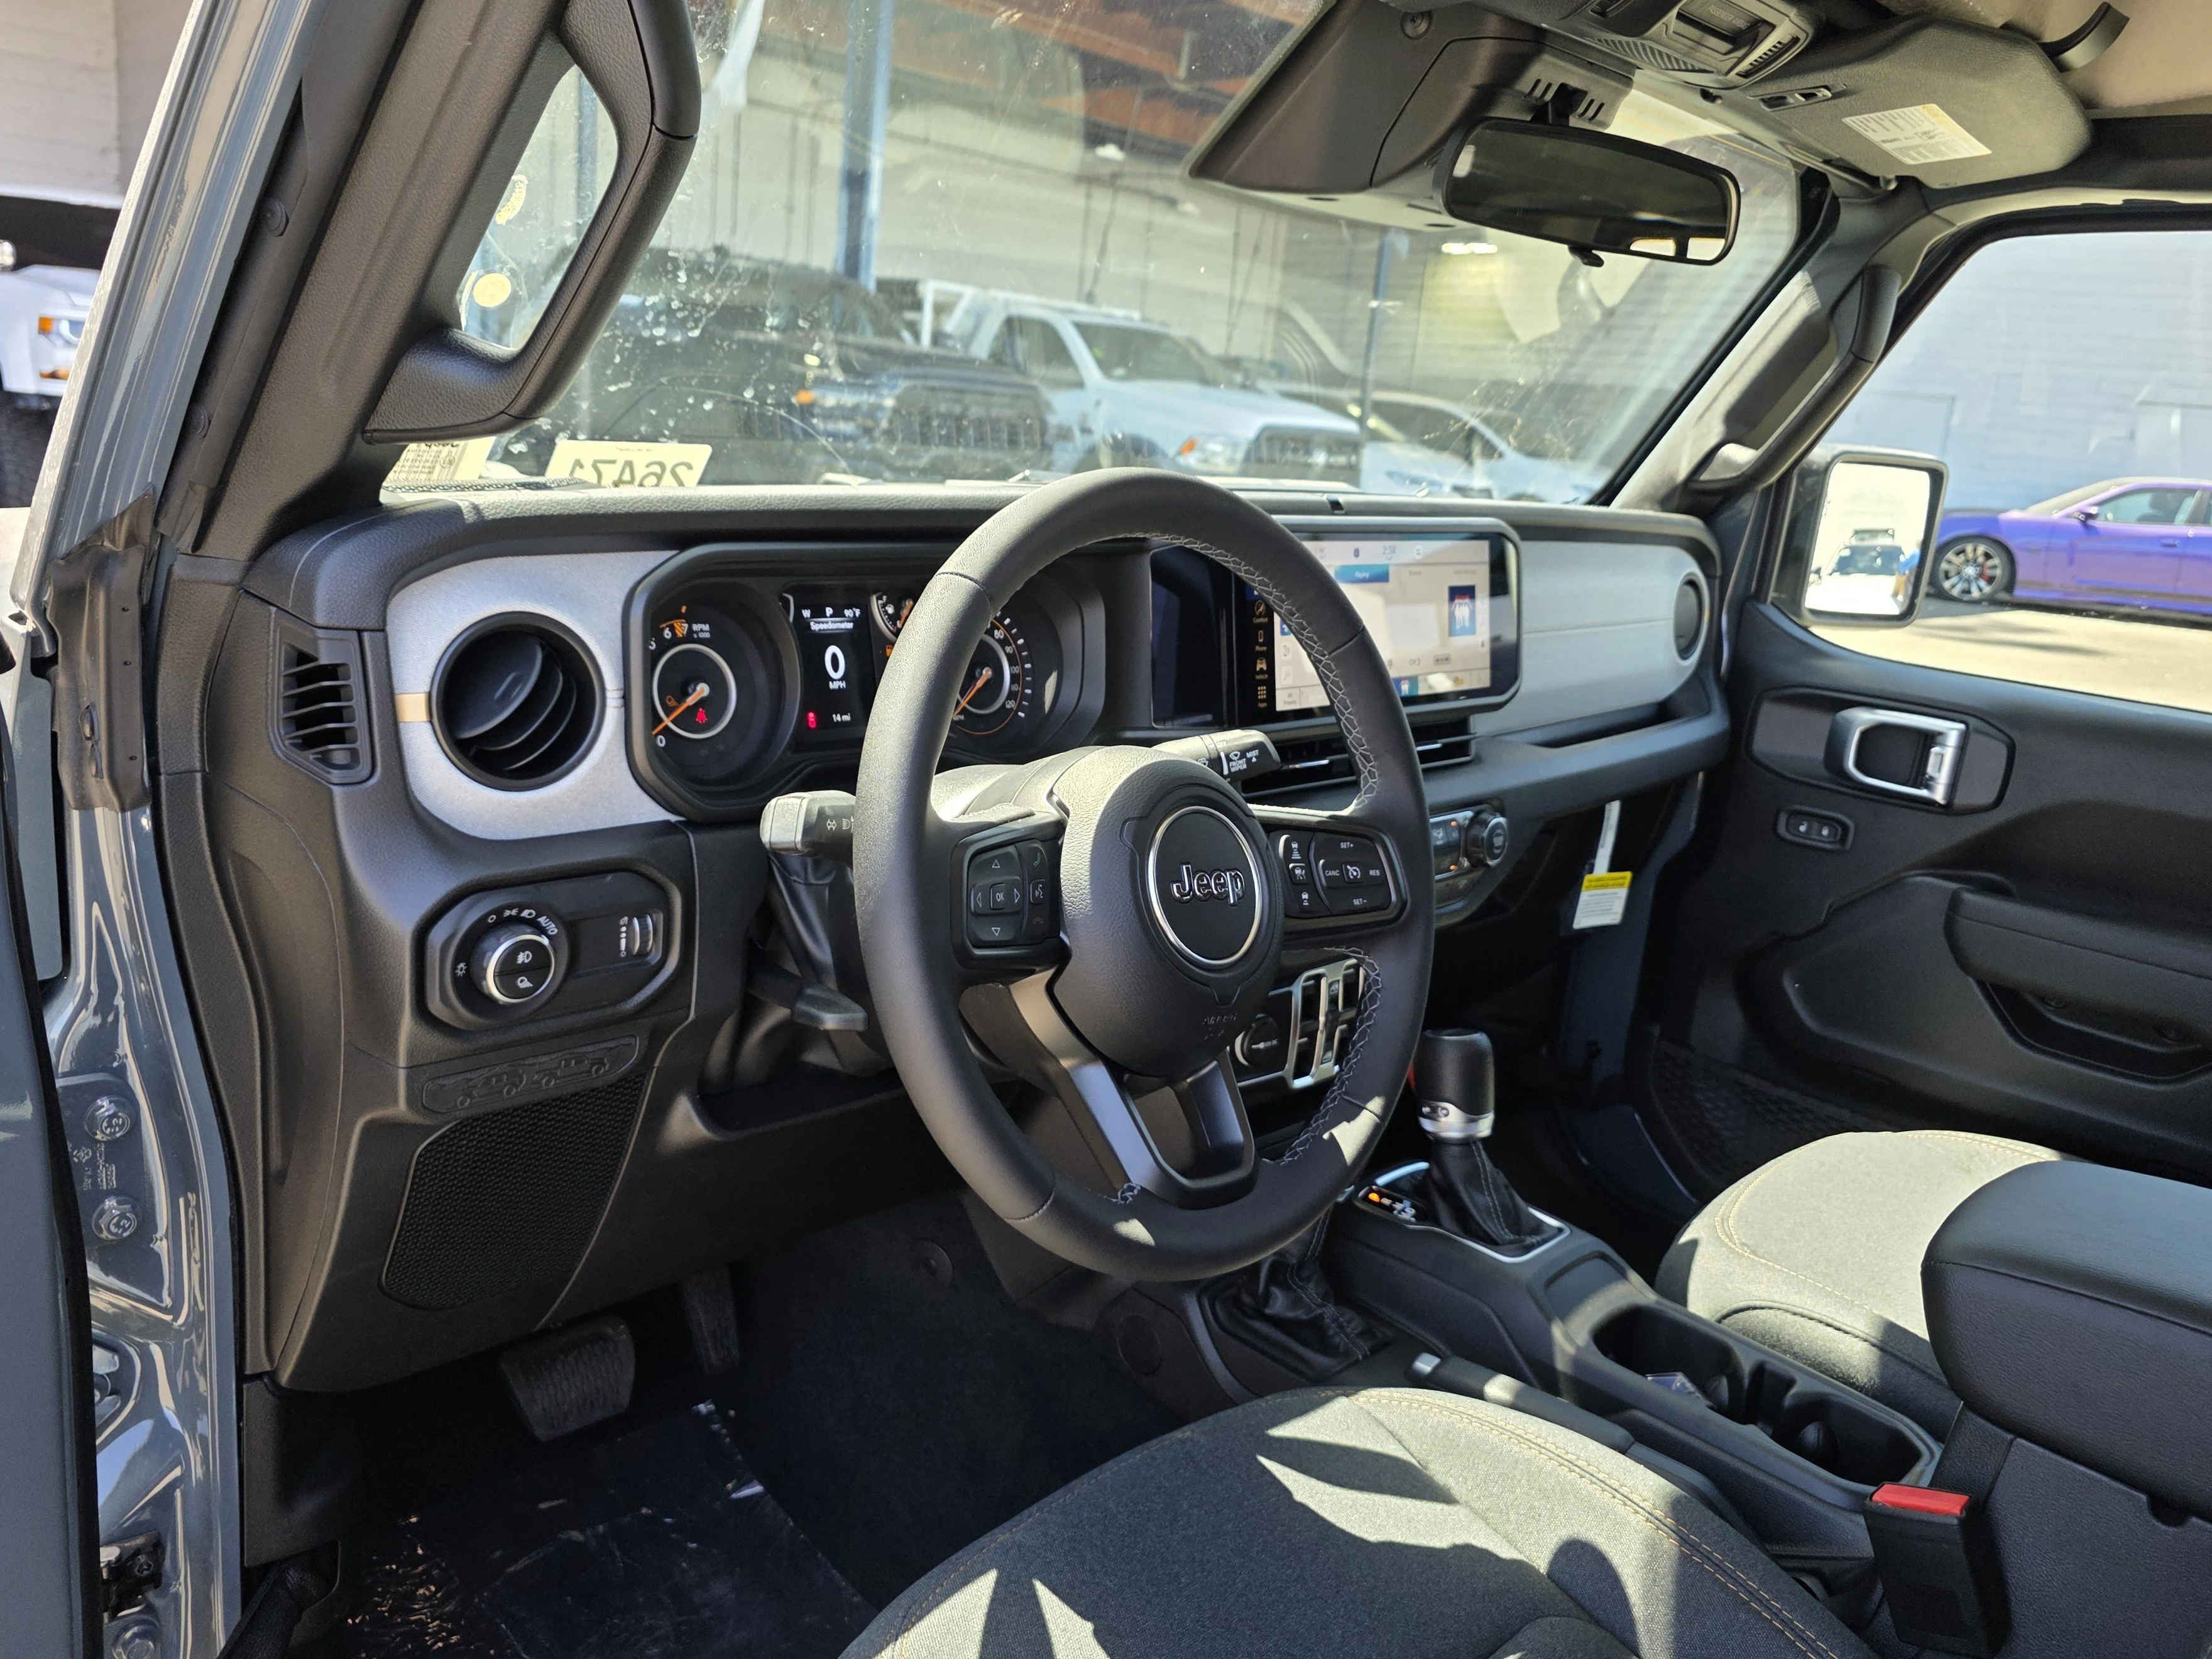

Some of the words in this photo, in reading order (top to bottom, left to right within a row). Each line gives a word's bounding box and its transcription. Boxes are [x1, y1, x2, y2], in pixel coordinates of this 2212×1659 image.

[801, 608, 811, 618] W
[825, 606, 833, 617] P
[663, 627, 672, 639] 6
[681, 623, 689, 636] 7
[692, 623, 710, 632] RPM
[809, 621, 854, 632] Speedometer
[994, 629, 1004, 640] 80
[824, 645, 845, 679] 0
[829, 680, 846, 690] MPH
[832, 713, 841, 723] 14
[841, 713, 851, 722] mi
[656, 735, 666, 747] 0
[1246, 749, 1259, 758] MIST
[1229, 758, 1246, 768] FRONT
[1170, 863, 1245, 906] Jeep
[996, 892, 1005, 902] OK
[537, 916, 558, 935] AUTO
